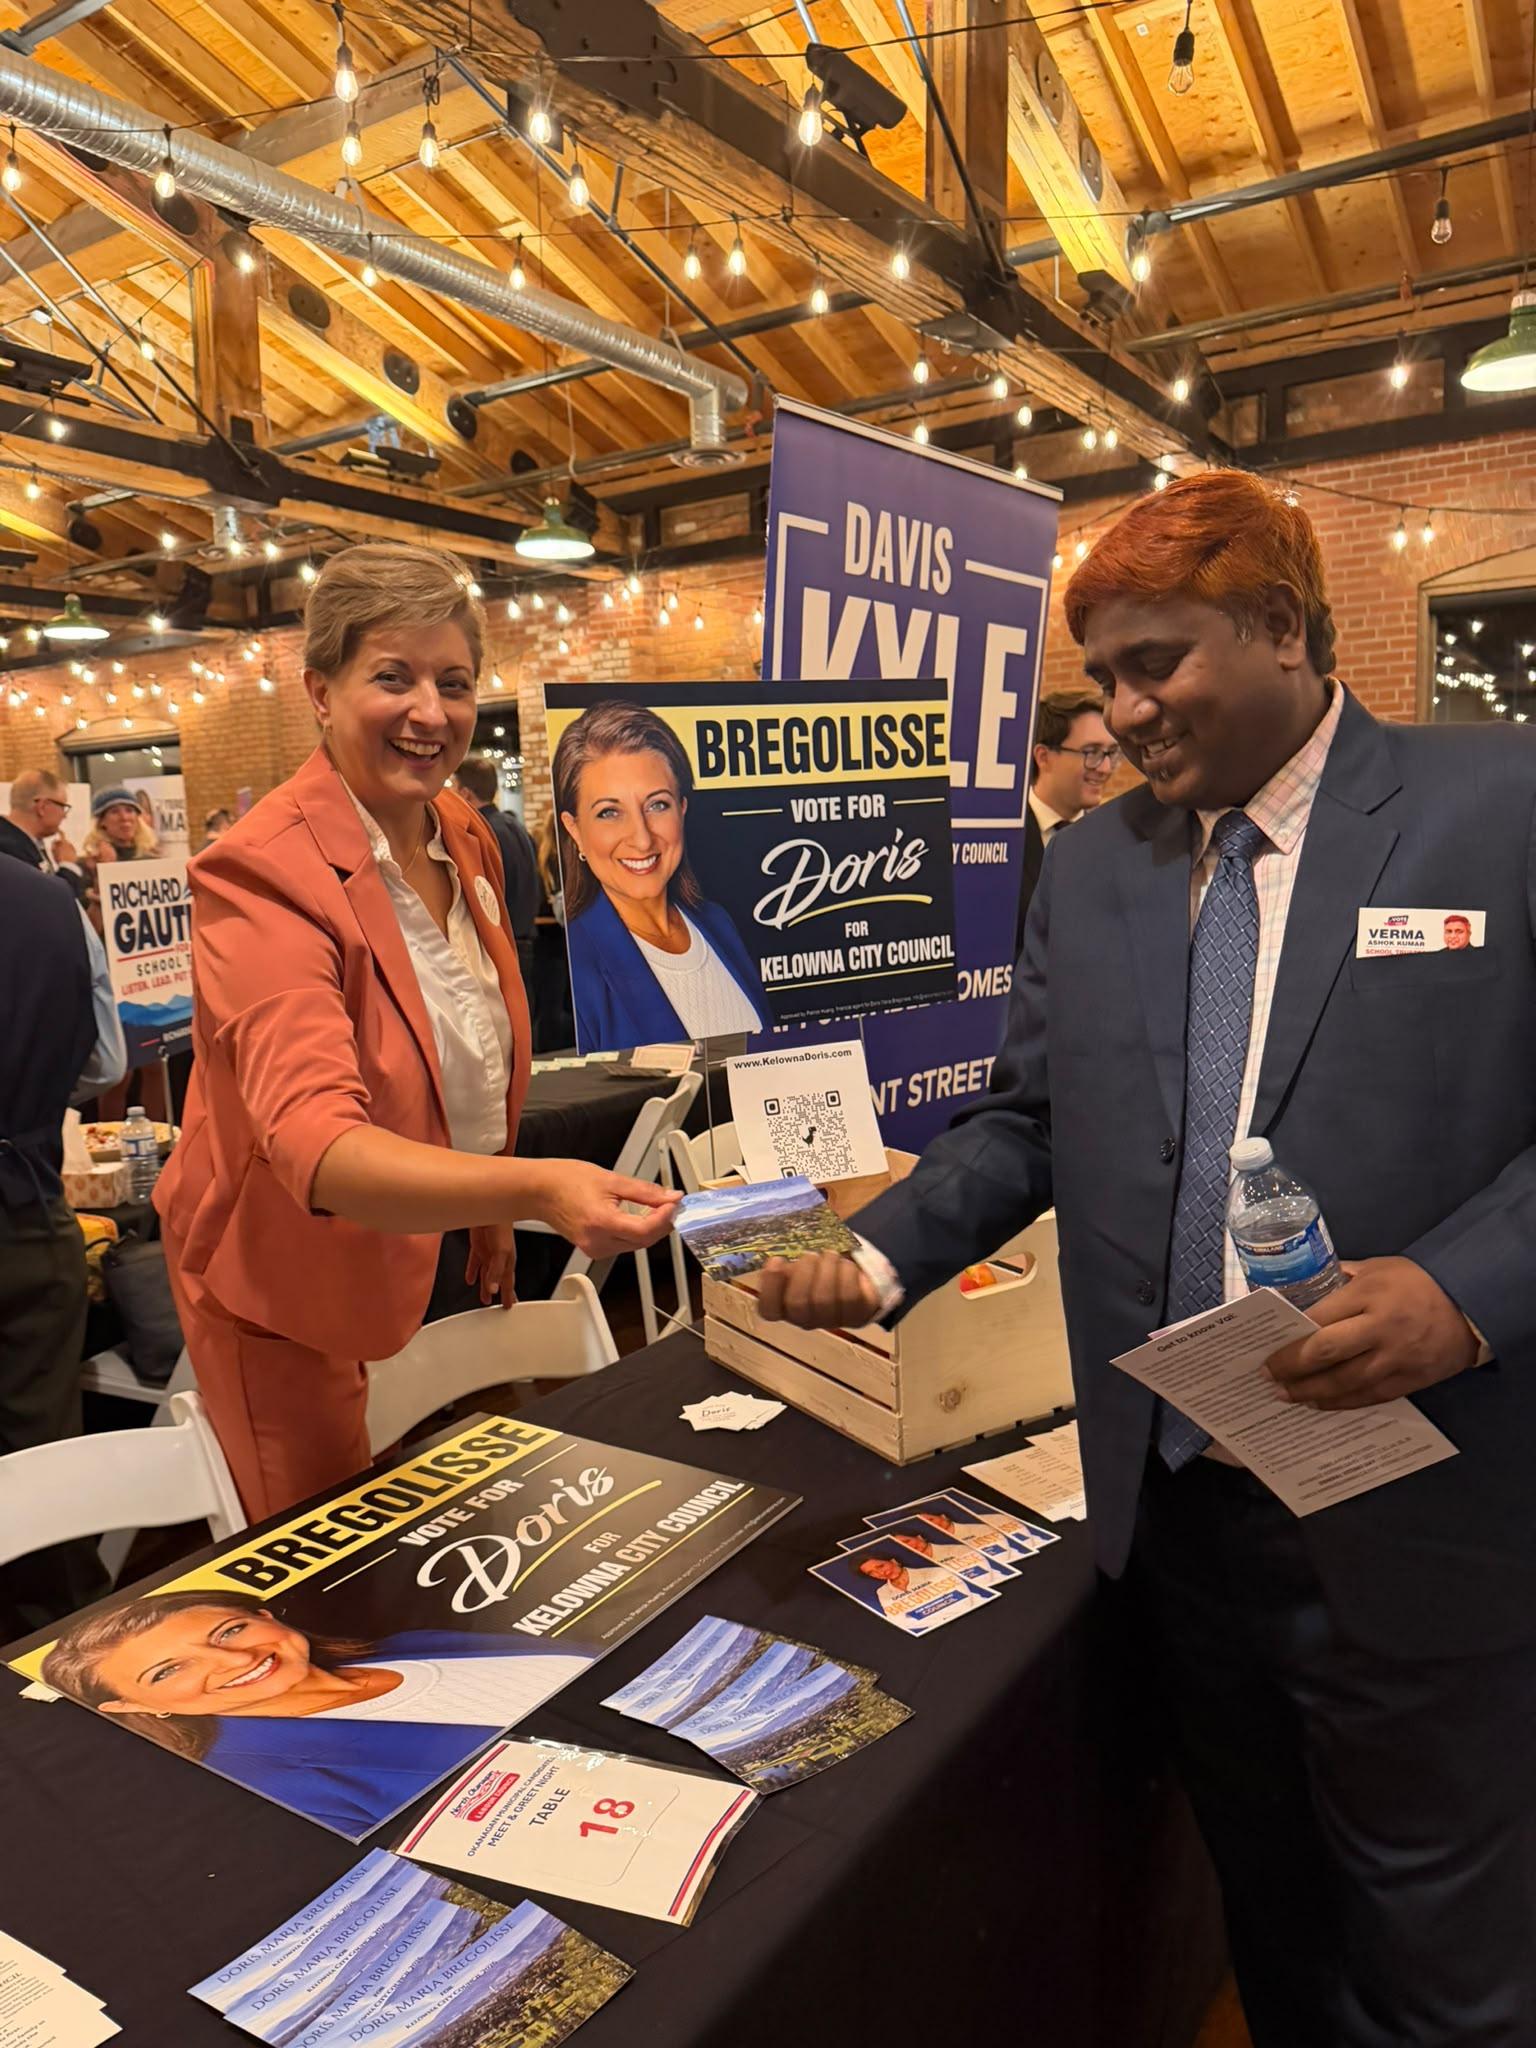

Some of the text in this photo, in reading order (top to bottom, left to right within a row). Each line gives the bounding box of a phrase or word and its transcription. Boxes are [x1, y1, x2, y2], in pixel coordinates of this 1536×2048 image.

[844, 501, 953, 595] DAVIS
[695, 713, 946, 778] BREGOLISSE
[790, 794, 886, 823] VOTE FOR
[961, 843, 1009, 865] COUNCIL
[109, 878, 181, 910] RICHARD
[753, 827, 929, 930] Doris
[845, 921, 869, 938] FOR
[1368, 929, 1425, 940] VERMA
[137, 959, 182, 977] SCHOOL
[760, 935, 955, 982] KELOWNA CITY COUNCIL
[957, 963, 1013, 1001] OMES
[734, 1049, 852, 1069] www.KelownaDoris.com
[215, 1422, 547, 1591] BREGOLISSE
[398, 1479, 525, 1547] VOTE FOR
[416, 1466, 615, 1613] Doris
[512, 1560, 632, 1637] KELOWNA
[615, 1529, 670, 1563] CITY
[656, 1480, 745, 1533] COUNCIL
[583, 1531, 622, 1554] FOR
[885, 1576, 961, 1616] BREGOLISSE
[450, 1796, 469, 1816] North
[467, 1816, 500, 1857] OKANAGAN
[496, 1787, 526, 1818] MUNICIPAL
[488, 1766, 560, 1847] MEET & GREET NIGHT
[529, 1787, 571, 1826] TABLE
[579, 1798, 635, 1838] 18
[217, 1866, 370, 1984] DORIS MARIA BREGOLISSE
[252, 1886, 402, 2011] DORIS MARIA BREGOLISSE
[331, 1983, 373, 2021] MARIA
[369, 1918, 431, 1982] BREGOLISSE
[348, 1920, 516, 2043] DORIS MARIA BREGOLISSE
